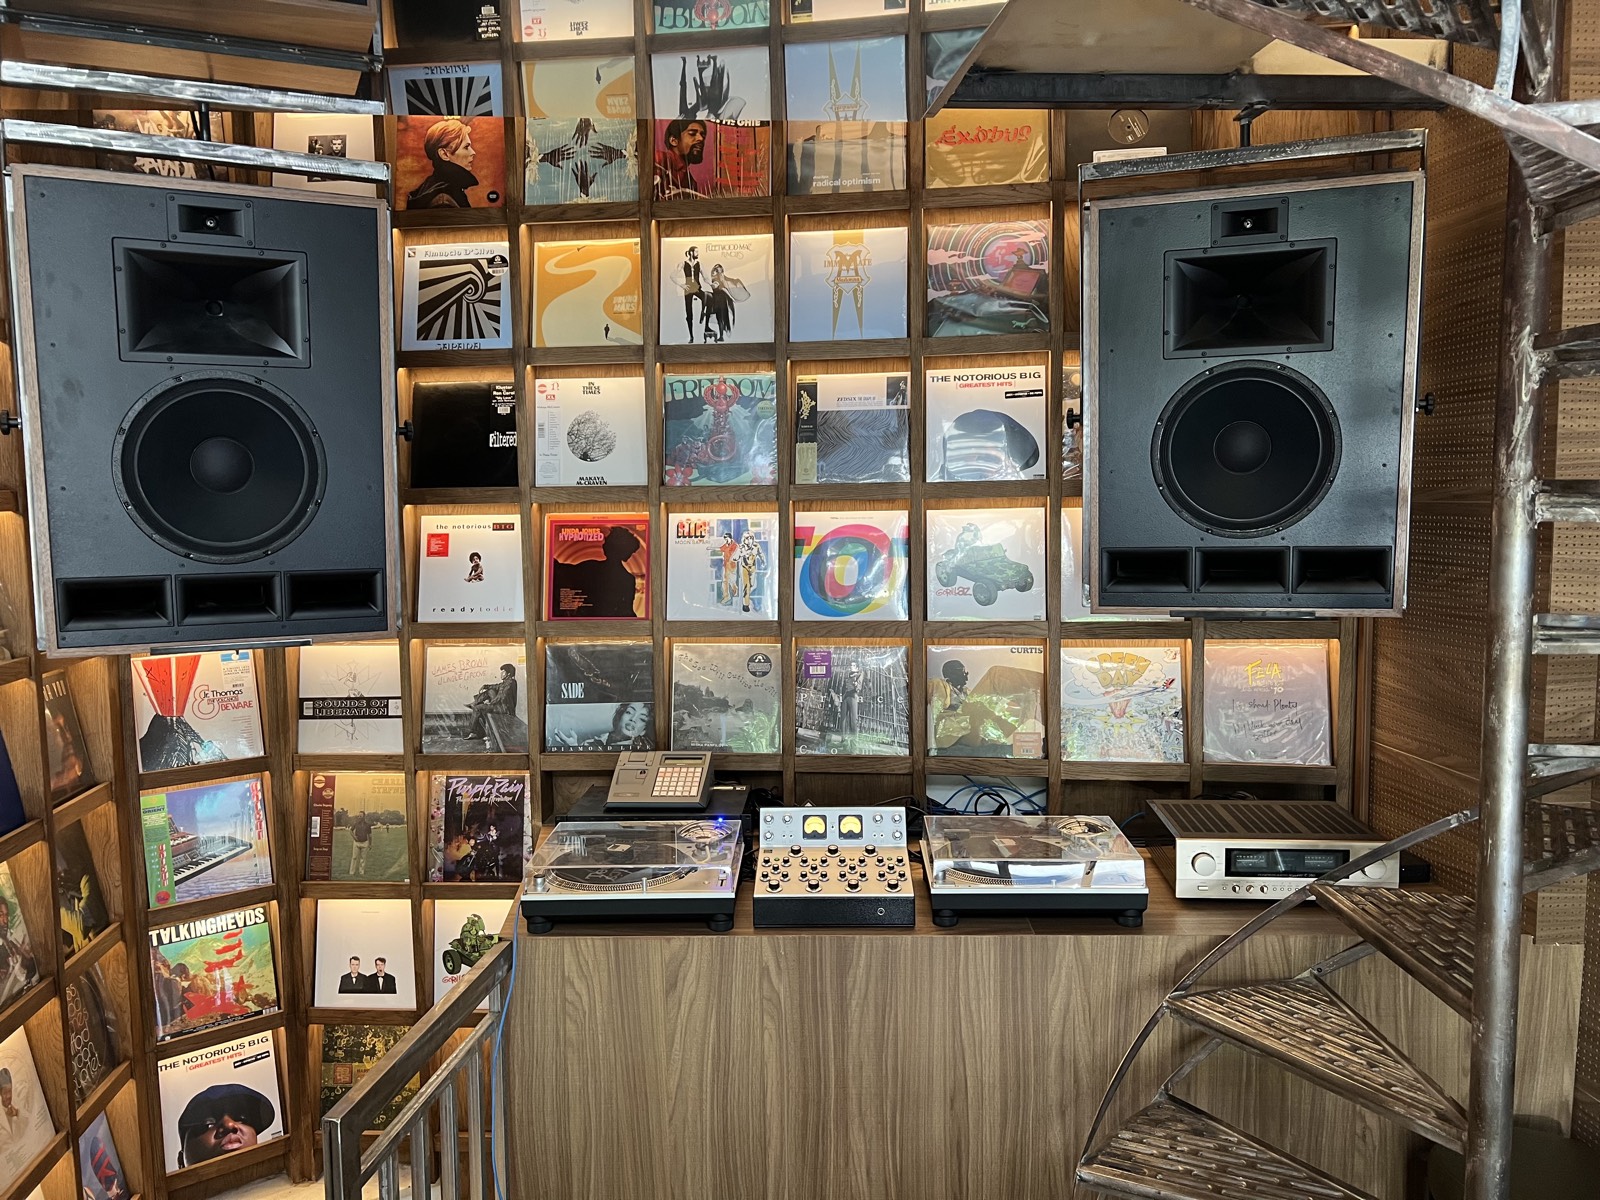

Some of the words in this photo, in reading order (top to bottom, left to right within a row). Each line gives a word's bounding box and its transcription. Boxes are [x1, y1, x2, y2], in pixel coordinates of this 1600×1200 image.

[813, 178, 841, 187] radical
[842, 177, 881, 187] optimism
[613, 295, 638, 304] BRUNO
[613, 303, 635, 312] MARS
[953, 372, 1017, 382] NOTORIOUS
[1019, 371, 1041, 380] BIG
[489, 431, 517, 447] Filtered
[676, 519, 707, 539] AIR
[432, 663, 457, 675] JAMES
[459, 657, 488, 671] BROWN
[1244, 659, 1282, 687] FELA
[1097, 669, 1142, 689] DAY
[211, 689, 243, 698] Thomas
[561, 682, 585, 699] SADE
[221, 700, 254, 711] BEWARE
[313, 699, 367, 708] SOUNDS
[370, 699, 388, 708] OF
[314, 707, 387, 717] LIBERATION
[447, 777, 494, 802] Purple
[492, 778, 524, 802] Rain
[158, 1061, 180, 1072] THE
[182, 1042, 246, 1066] NOTORIOUS
[248, 1036, 269, 1047] BIG
[189, 1057, 225, 1071] GREATEST
[226, 1051, 242, 1060] HITS
